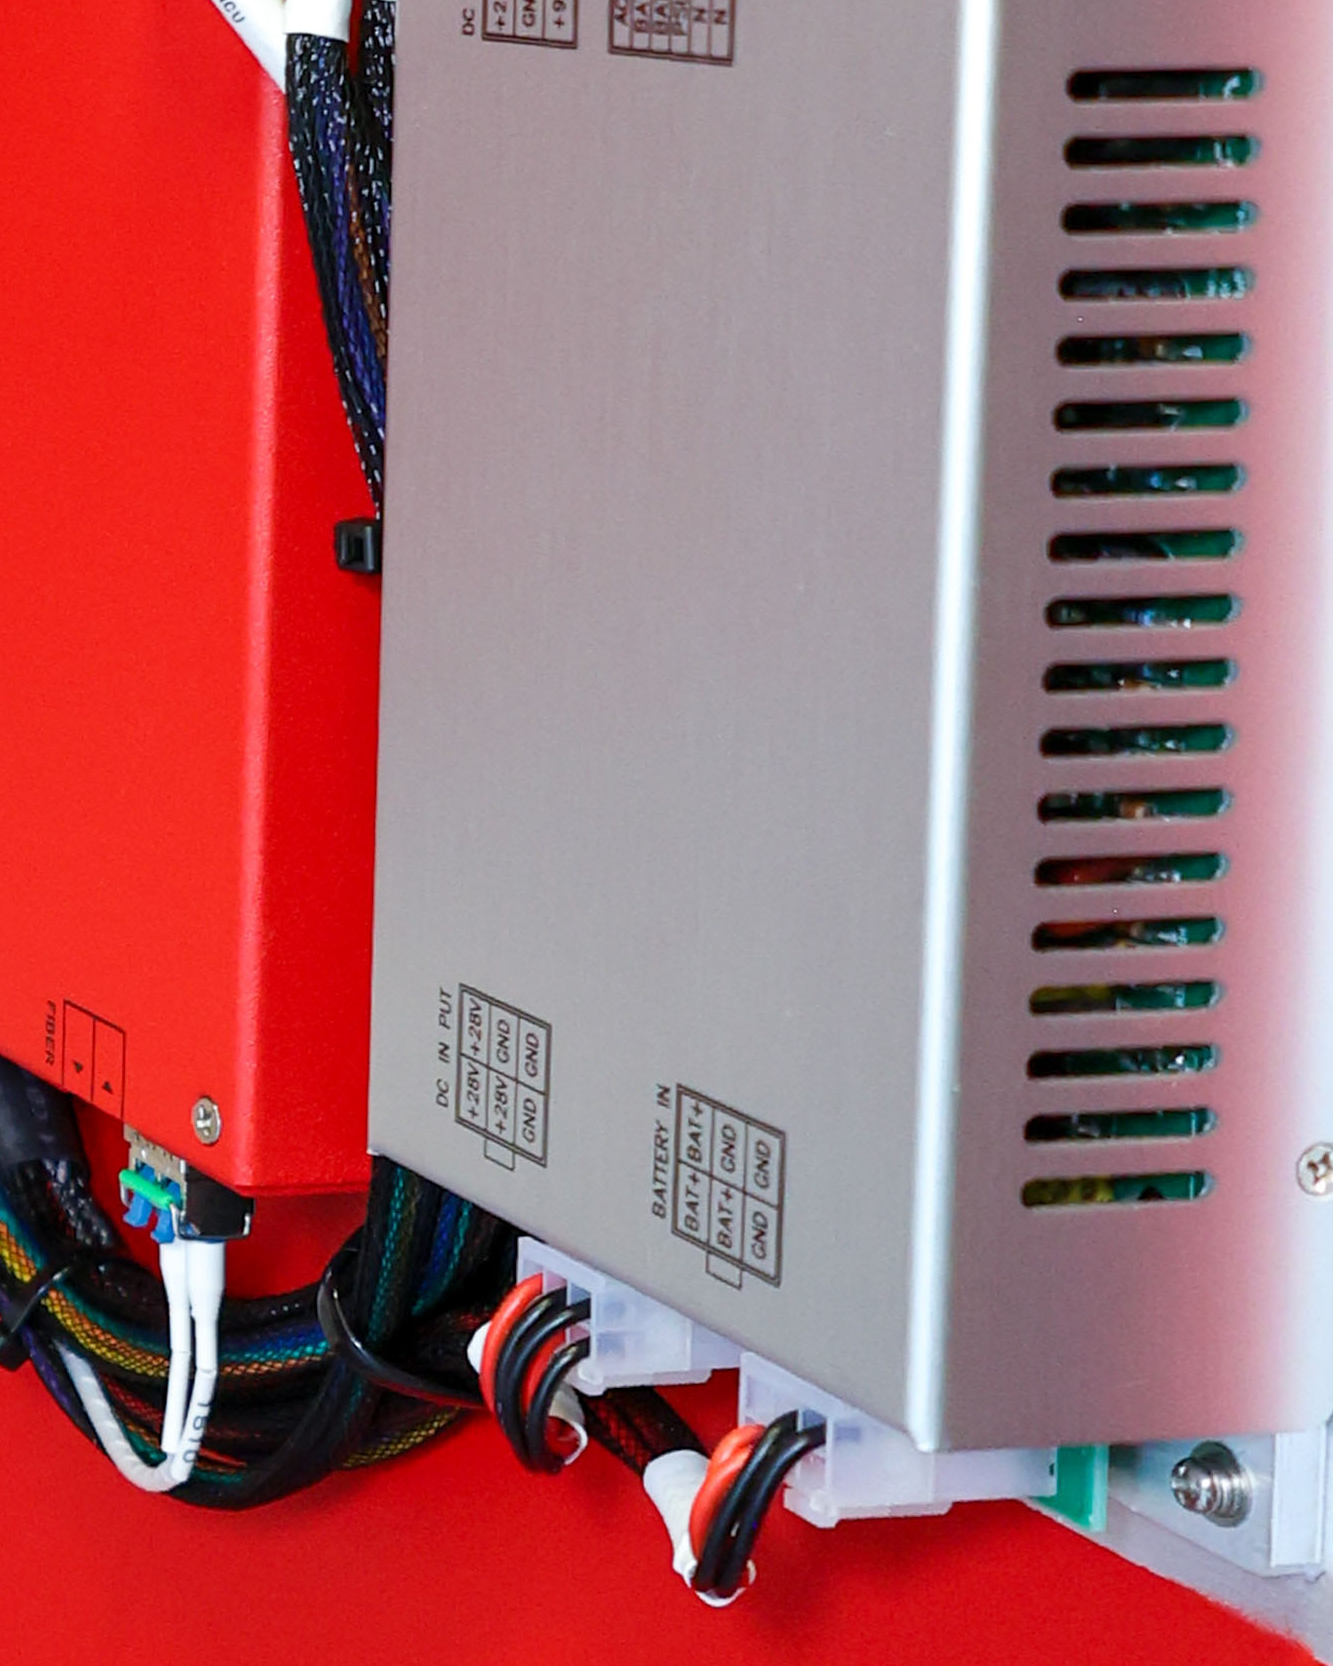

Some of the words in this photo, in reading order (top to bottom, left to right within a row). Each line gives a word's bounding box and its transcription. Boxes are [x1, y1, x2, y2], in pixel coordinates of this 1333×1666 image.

[462, 9, 476, 36] DC
[44, 999, 57, 1067] FIBER
[438, 988, 453, 1030] PUT
[469, 998, 483, 1057] +28V
[496, 1019, 511, 1064] GND
[524, 1032, 540, 1078] GND
[438, 1041, 451, 1064] IN
[436, 1080, 449, 1109] DC
[466, 1061, 481, 1120] +28V
[494, 1076, 510, 1135] +28V
[521, 1097, 538, 1144] GND
[657, 1084, 673, 1109] IN
[651, 1121, 670, 1220] BATTERY
[687, 1101, 704, 1163] BAT+
[720, 1124, 737, 1173] GND
[753, 1139, 772, 1190] GND
[683, 1172, 701, 1233] BAT+
[717, 1187, 735, 1250] BAT+
[751, 1211, 770, 1260] GND
